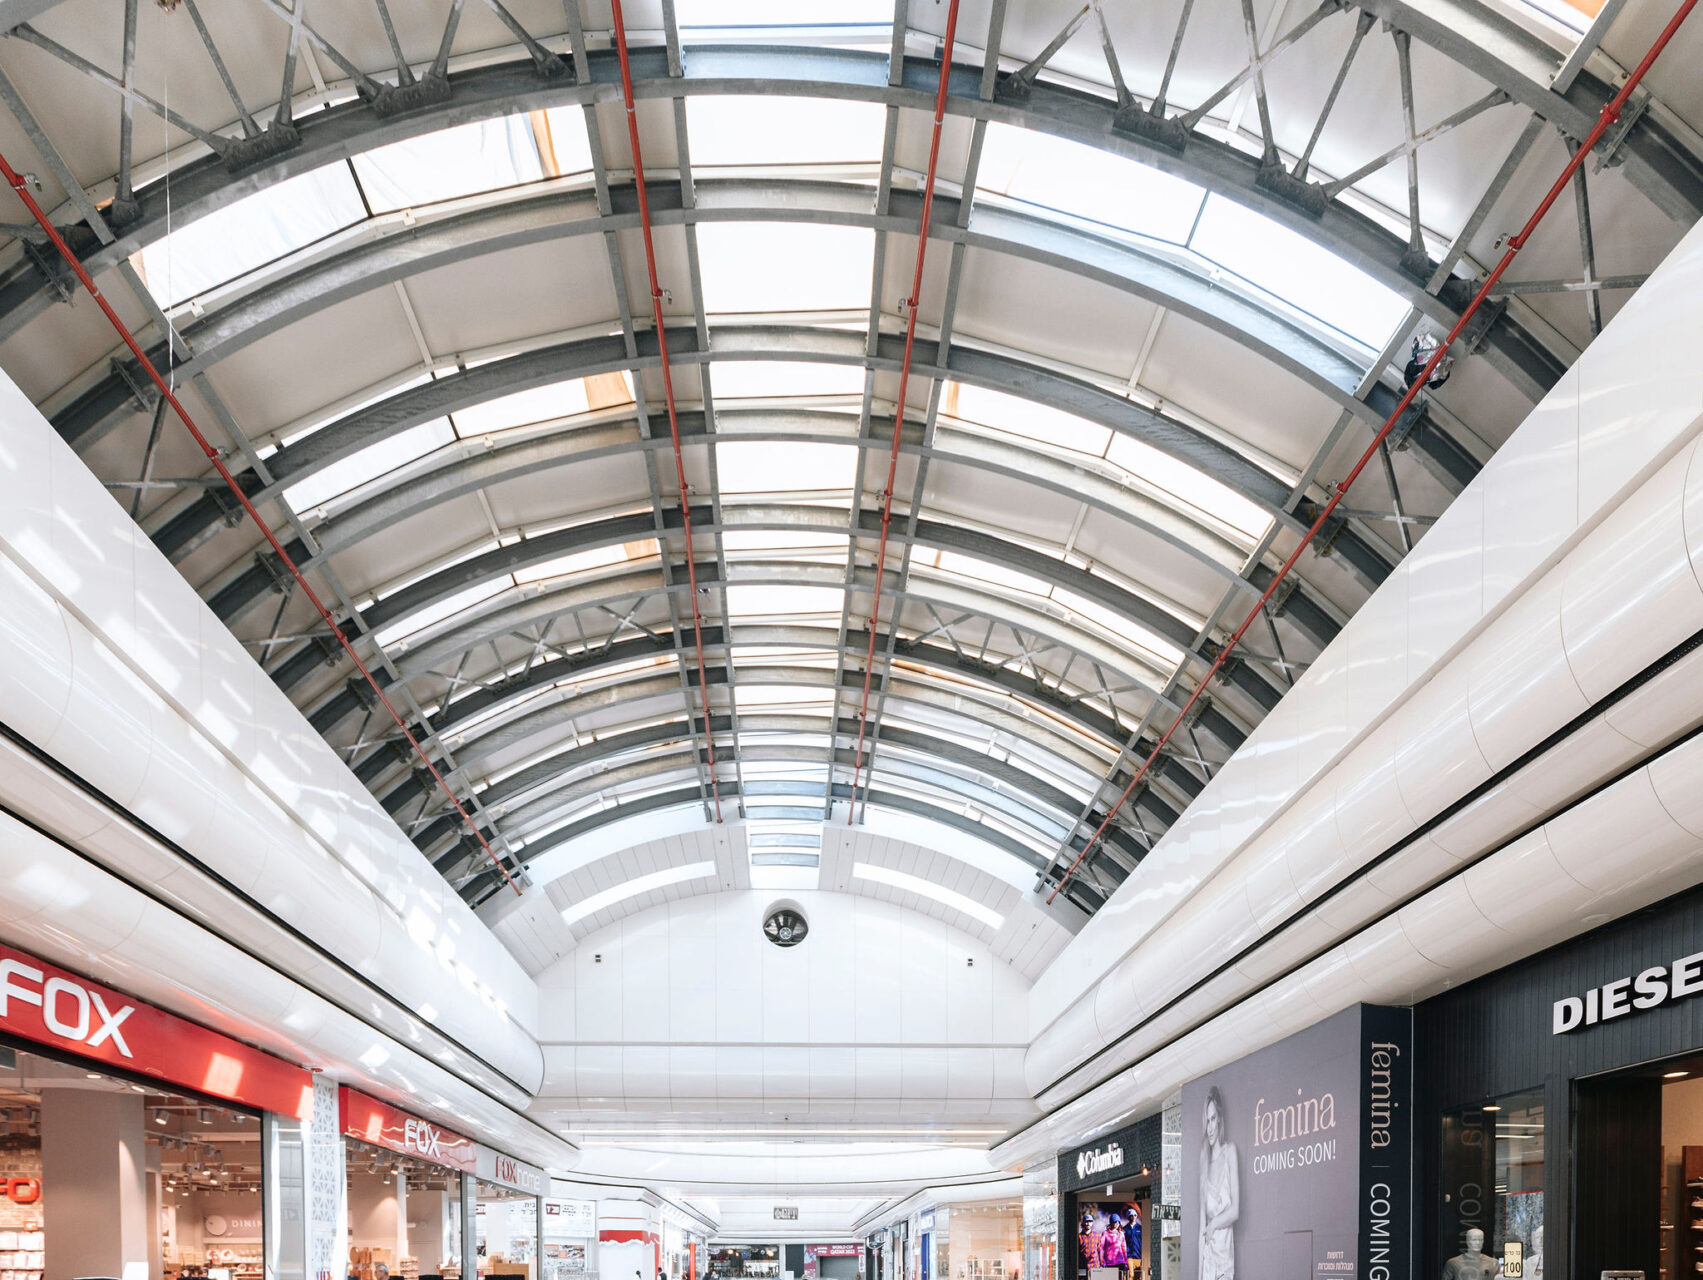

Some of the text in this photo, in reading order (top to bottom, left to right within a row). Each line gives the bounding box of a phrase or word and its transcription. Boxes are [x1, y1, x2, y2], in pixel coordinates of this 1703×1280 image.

[0, 959, 135, 1058] FOX
[1553, 951, 1703, 1035] DIESE
[1371, 1042, 1400, 1149] femina
[1254, 1088, 1336, 1146] femina
[404, 1118, 441, 1158] FOX
[1253, 1139, 1336, 1174] COMING SOON!
[1085, 1143, 1124, 1174] Columbia
[232, 1219, 263, 1228] DININ
[1504, 1262, 1521, 1273] 100
